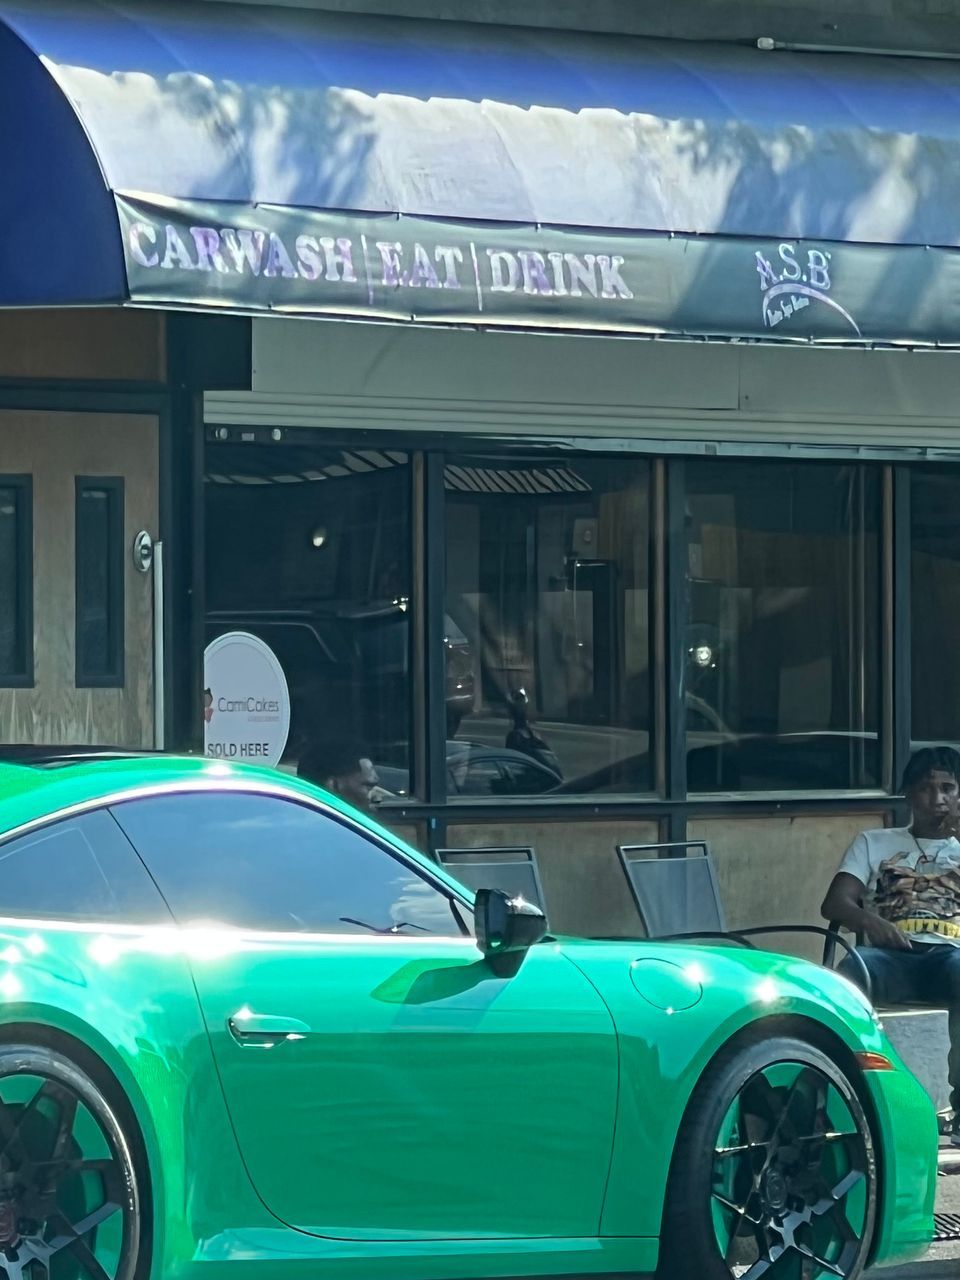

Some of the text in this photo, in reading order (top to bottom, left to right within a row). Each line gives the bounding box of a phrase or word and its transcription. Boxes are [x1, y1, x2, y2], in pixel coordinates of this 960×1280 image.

[129, 221, 634, 300] CARWASH EAT DRINK
[218, 697, 279, 712] CamiCakes
[207, 743, 270, 757] SOLD HERE
